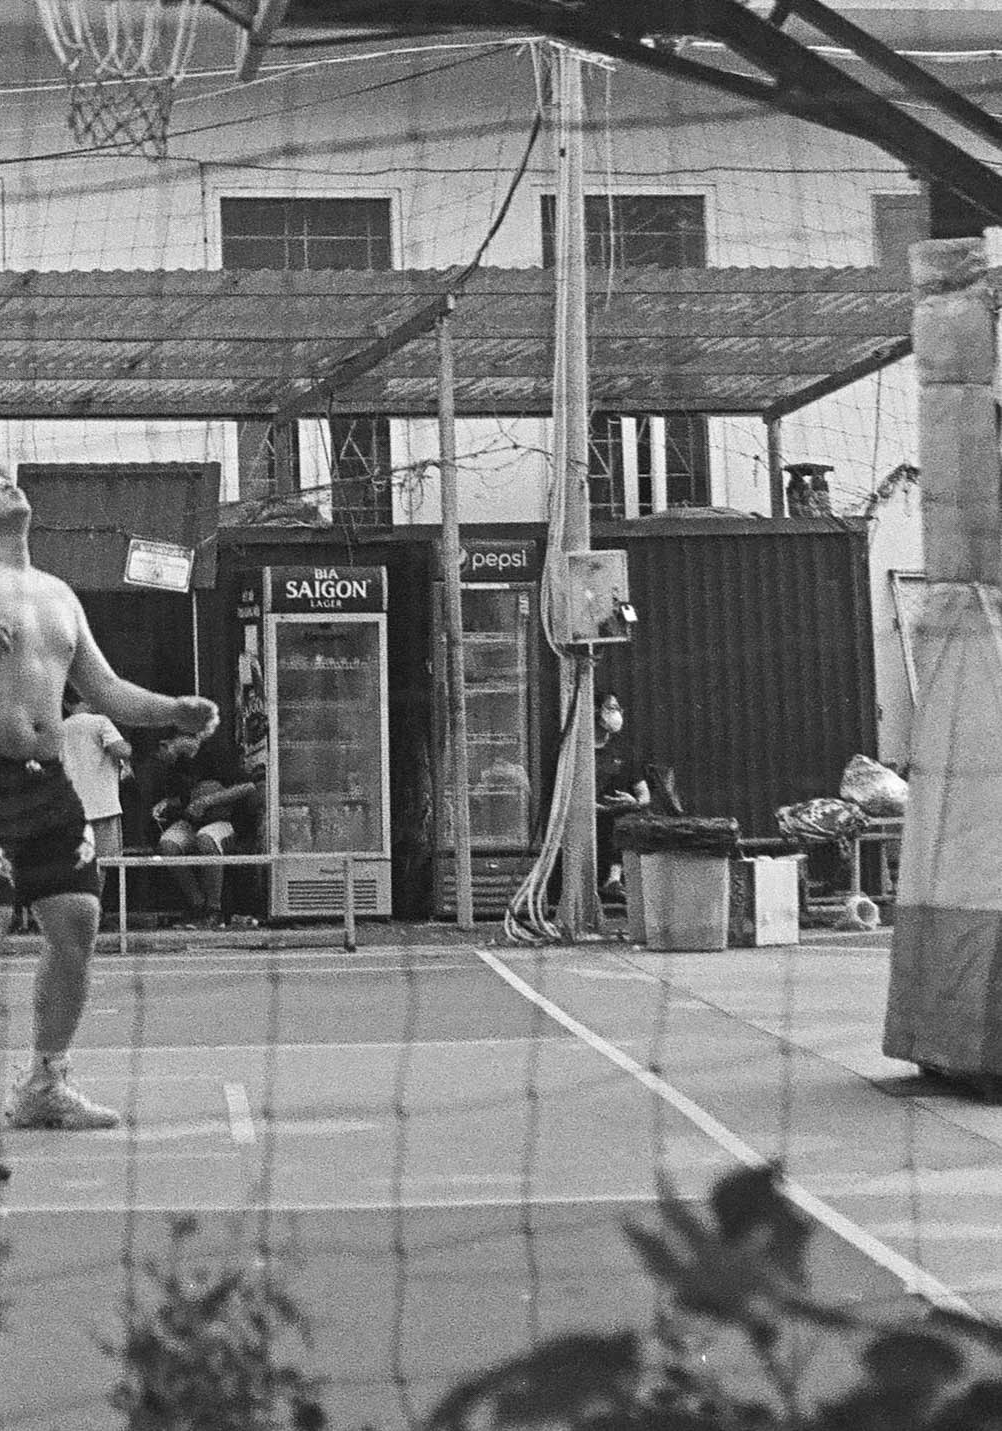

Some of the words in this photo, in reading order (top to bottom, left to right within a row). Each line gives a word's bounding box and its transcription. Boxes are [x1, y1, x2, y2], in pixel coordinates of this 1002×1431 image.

[472, 550, 527, 571] pepsi
[314, 568, 339, 580] BIA
[285, 580, 367, 599] SAIGON
[310, 599, 342, 608] LAGER
